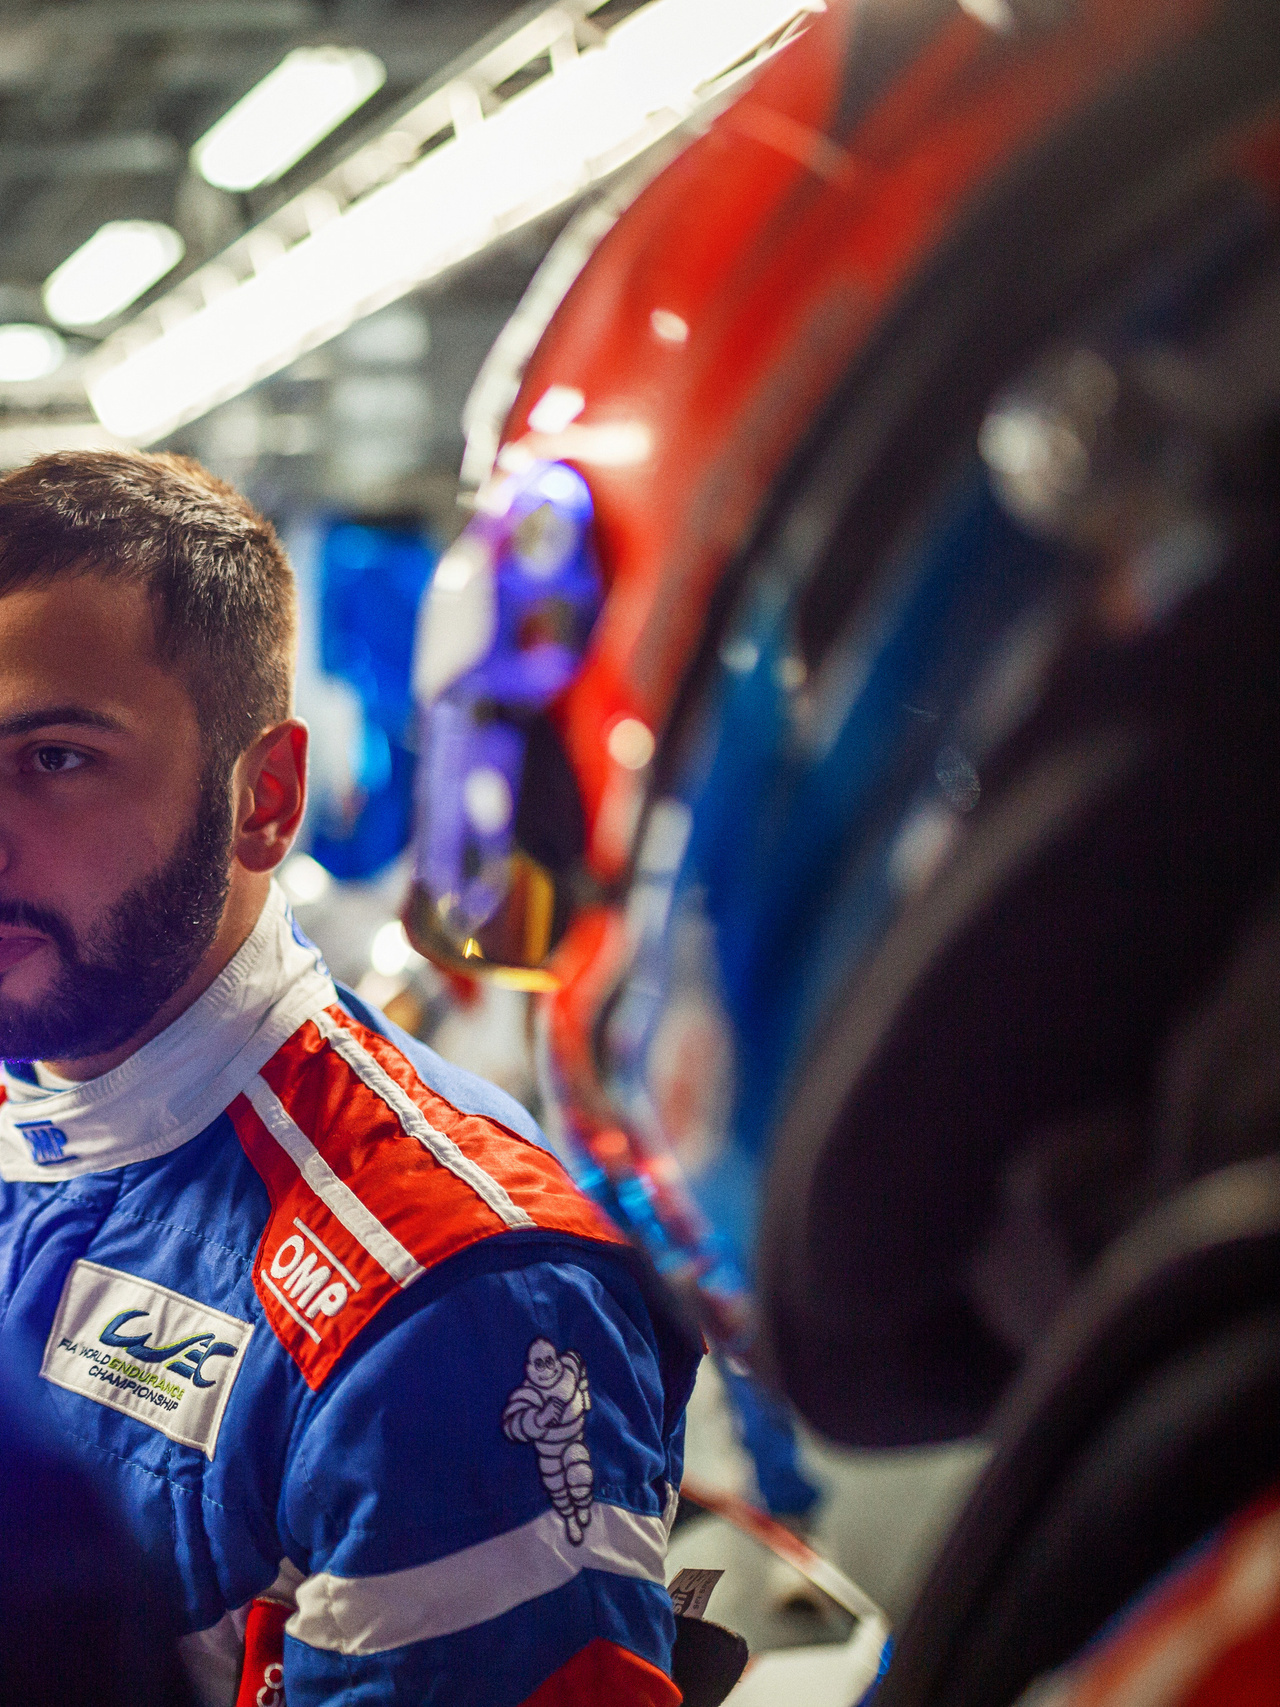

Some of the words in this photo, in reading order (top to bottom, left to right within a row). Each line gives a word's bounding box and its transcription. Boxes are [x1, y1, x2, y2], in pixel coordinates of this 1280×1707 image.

[269, 1233, 348, 1320] OMP
[57, 1337, 77, 1355] FIA
[80, 1345, 111, 1366] WORLD
[107, 1357, 185, 1400] ENDURANCE
[98, 1309, 238, 1388] WEC
[88, 1365, 179, 1412] CHAMPIONSHIP
